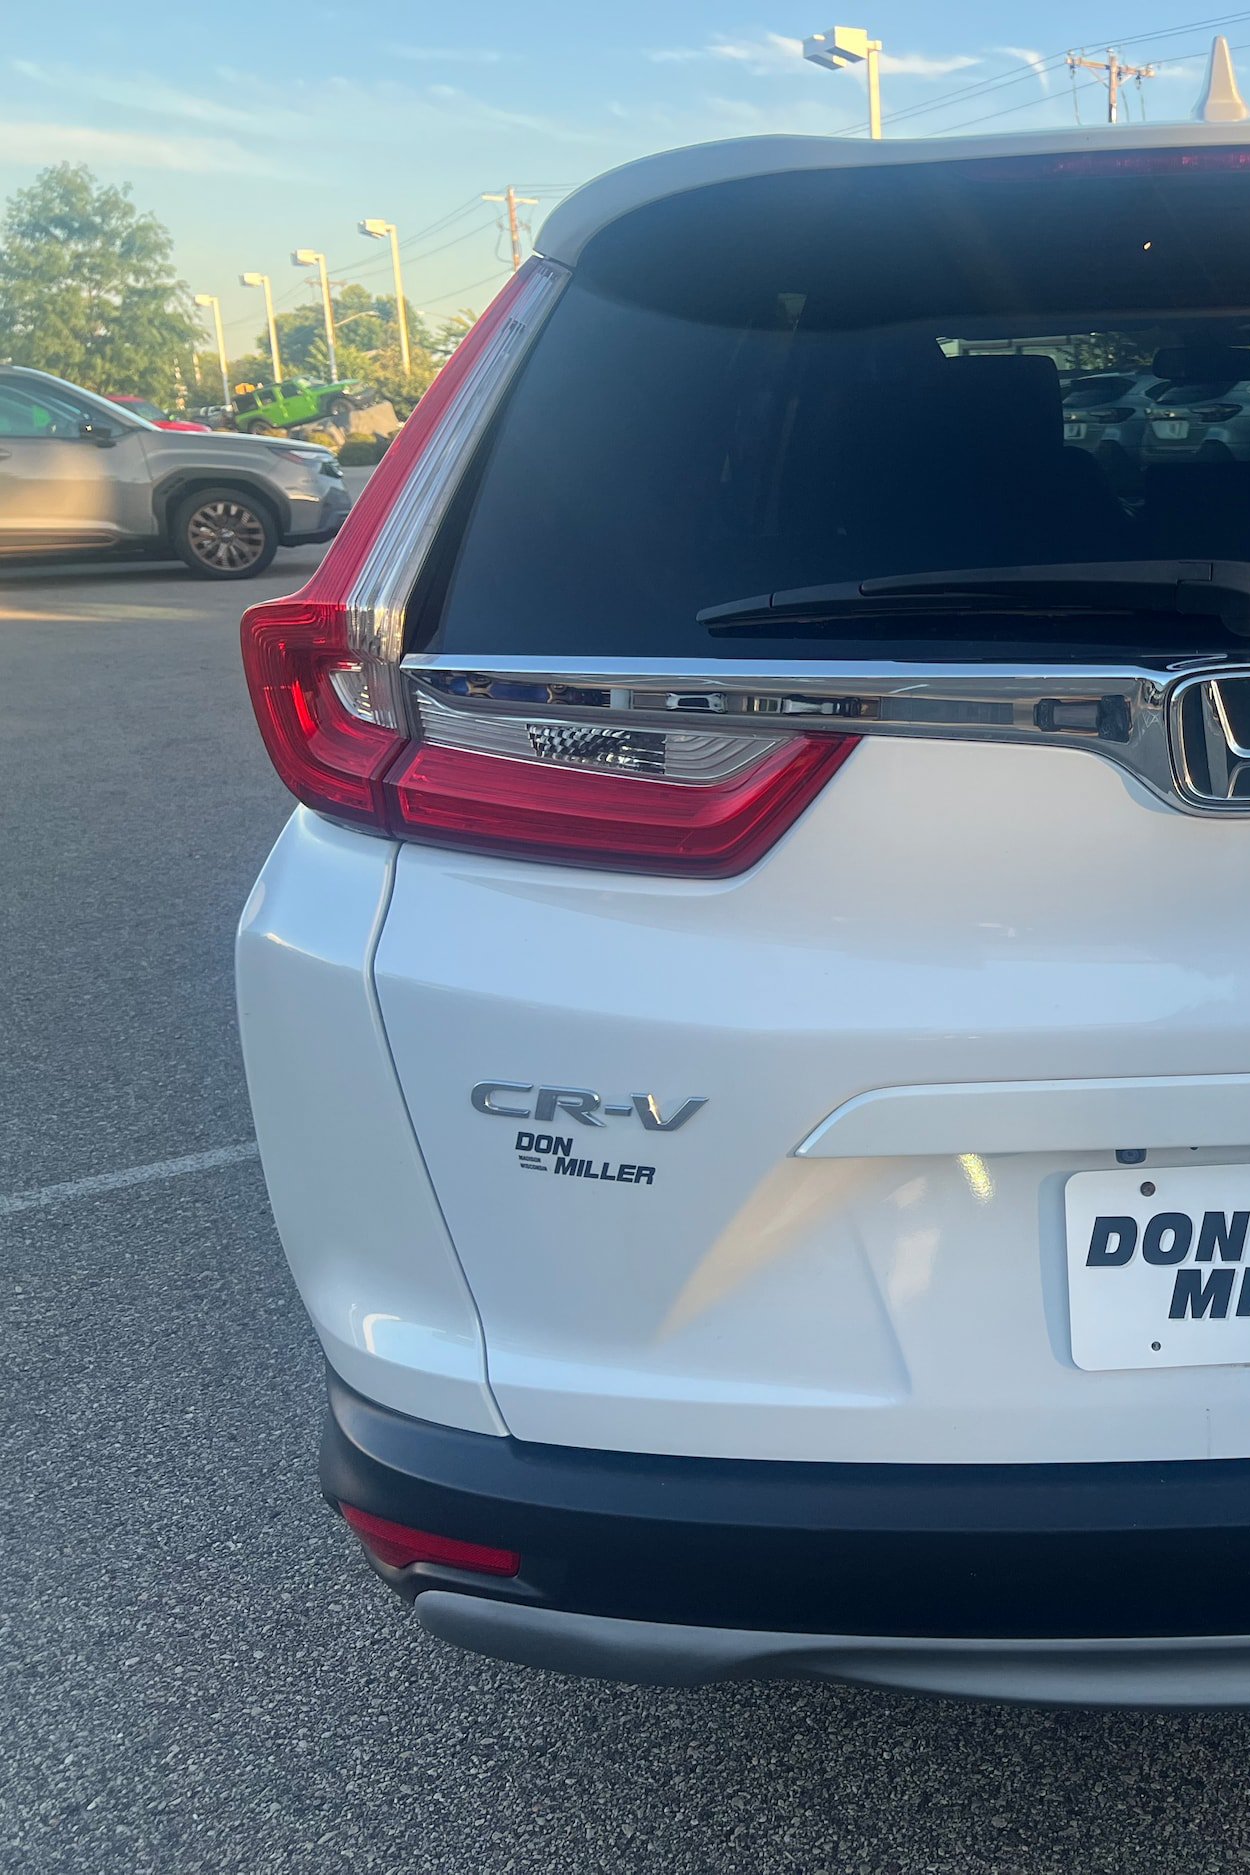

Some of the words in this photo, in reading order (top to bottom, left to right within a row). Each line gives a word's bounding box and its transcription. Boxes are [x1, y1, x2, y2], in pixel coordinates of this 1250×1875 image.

[471, 1079, 709, 1131] CR-V
[515, 1131, 573, 1157] DON
[554, 1157, 656, 1185] MILLER
